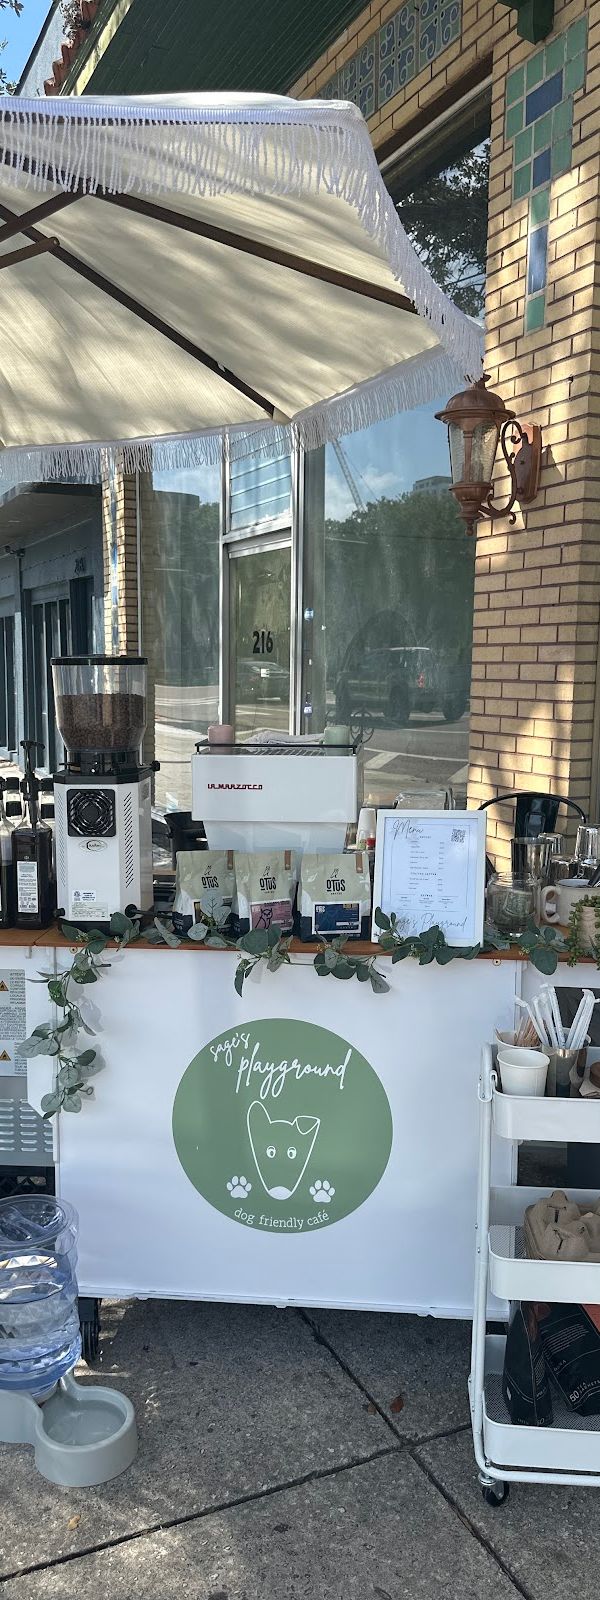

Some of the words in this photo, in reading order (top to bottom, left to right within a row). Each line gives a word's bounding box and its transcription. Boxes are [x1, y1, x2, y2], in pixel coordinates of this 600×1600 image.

[252, 631, 274, 654] 216
[393, 819, 423, 840] Menu
[201, 876, 220, 889] OTUS
[260, 877, 277, 890] OTUS
[326, 879, 346, 892] OTUS
[209, 1033, 251, 1067] sage's
[236, 1042, 352, 1100] playground
[234, 1207, 255, 1225] dog
[259, 1214, 304, 1230] friendly
[306, 1209, 330, 1226] café
[569, 1390, 580, 1403] 50
